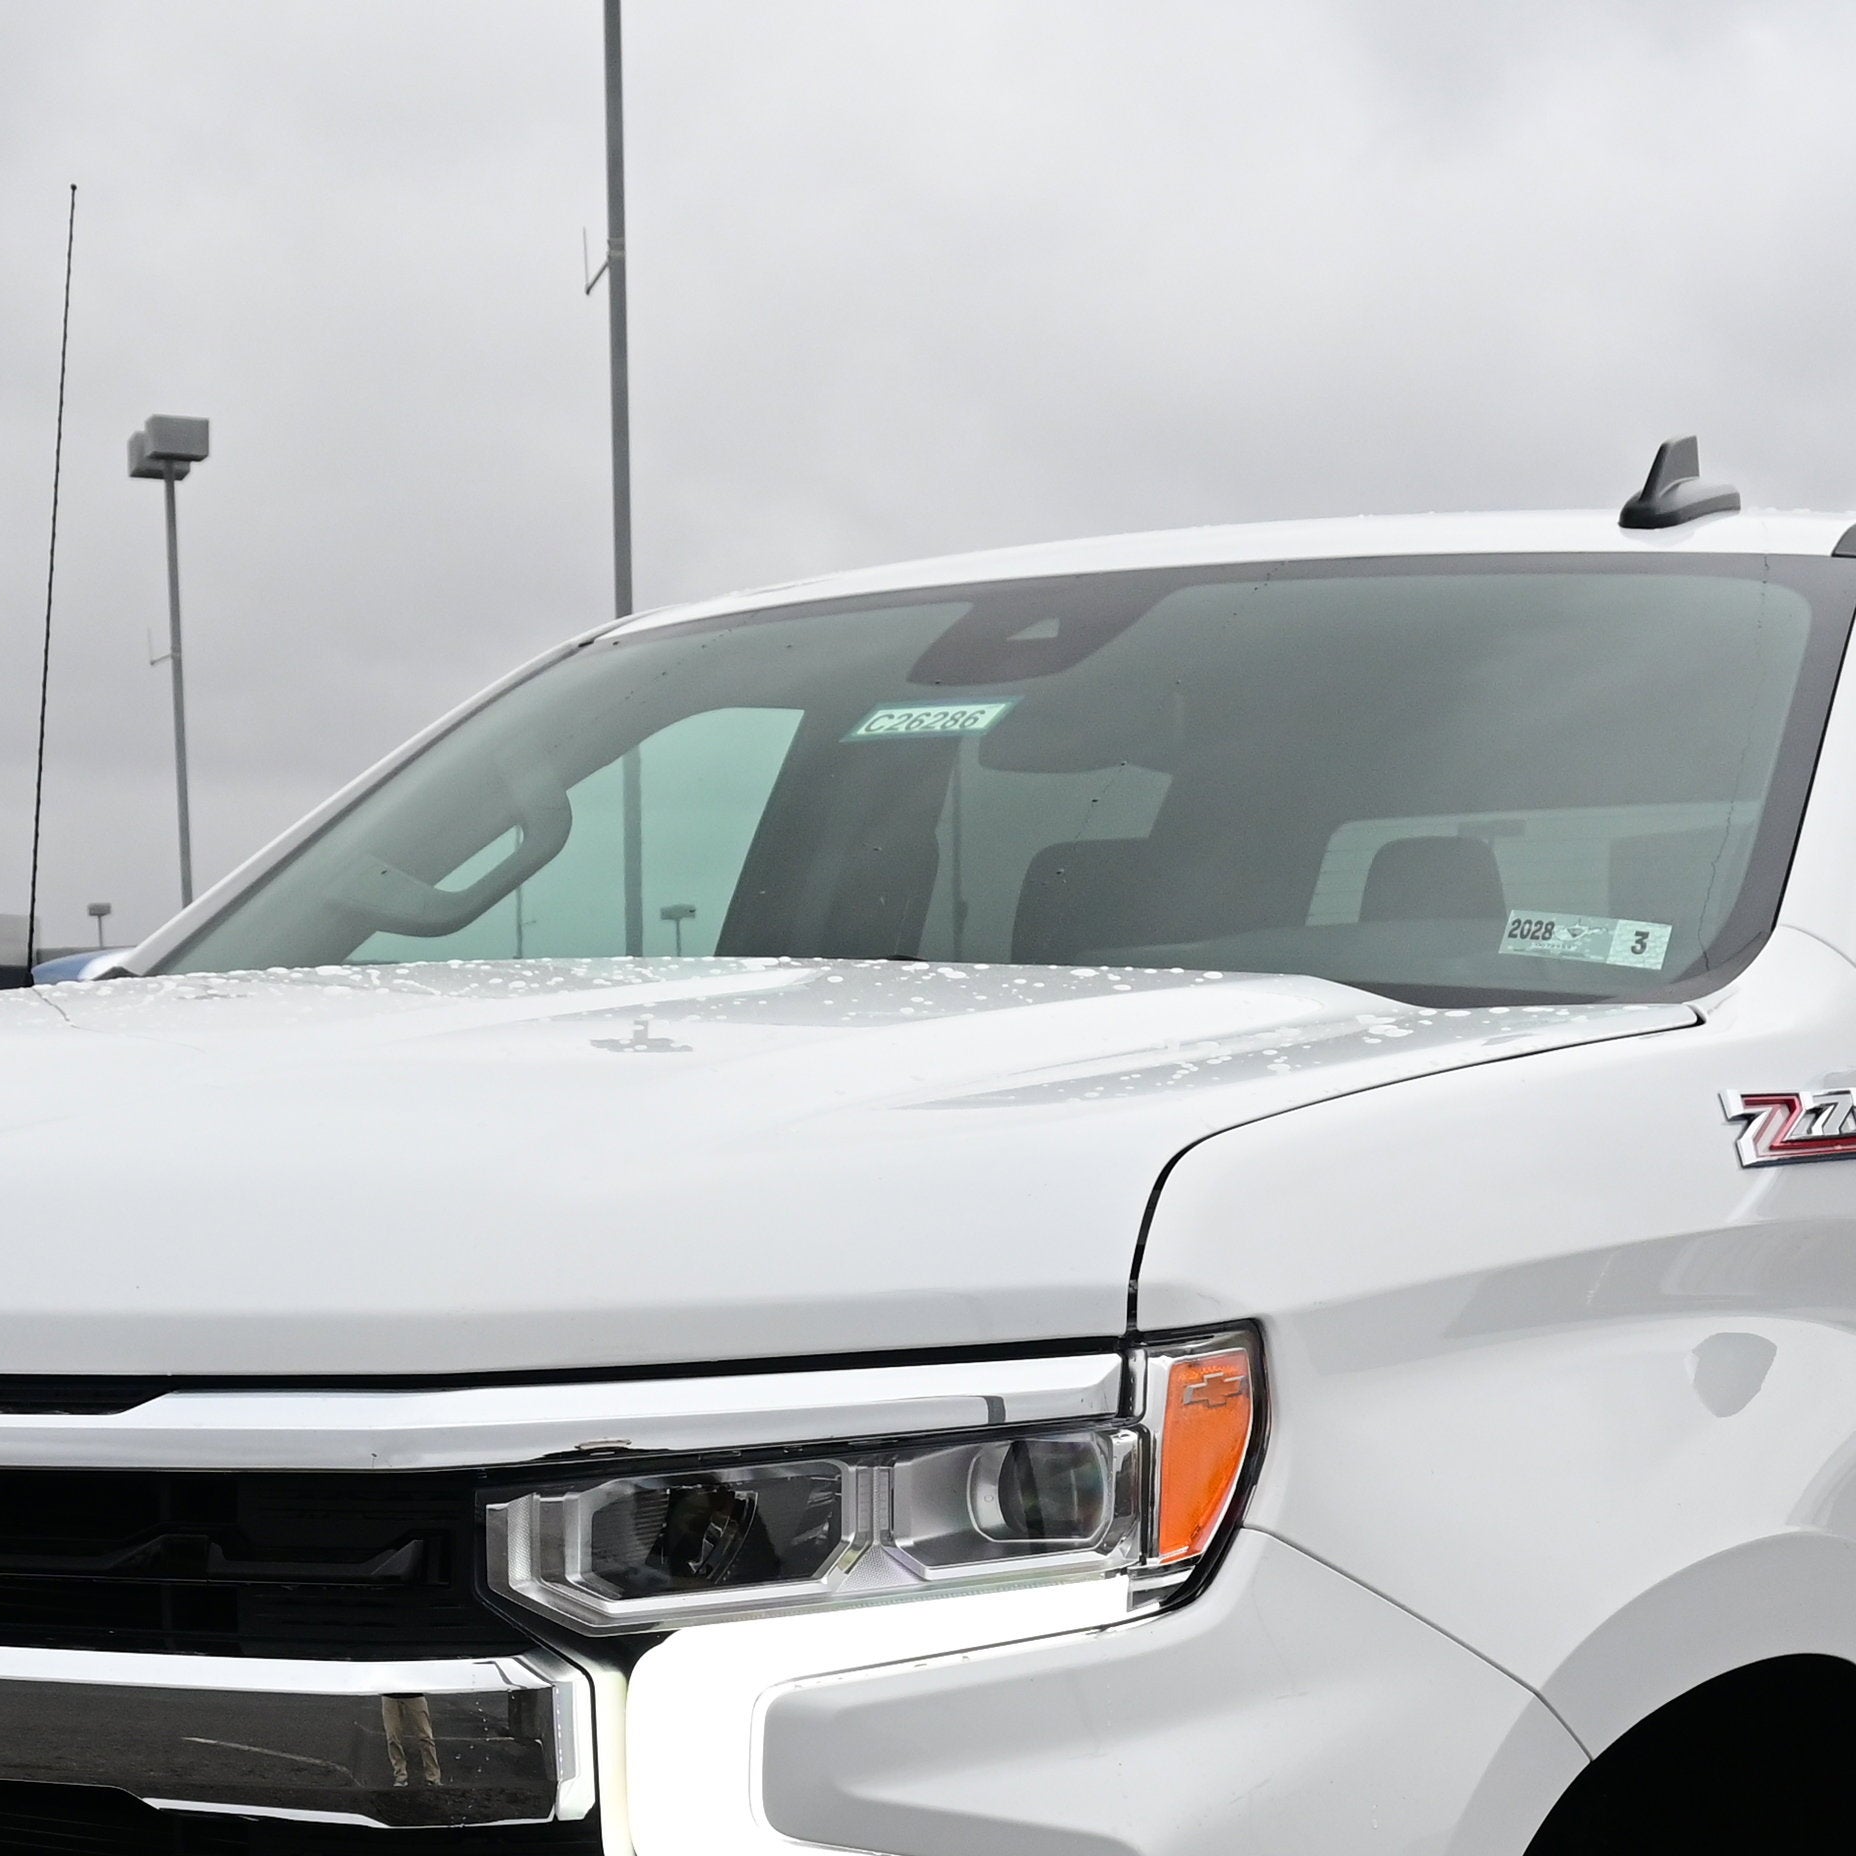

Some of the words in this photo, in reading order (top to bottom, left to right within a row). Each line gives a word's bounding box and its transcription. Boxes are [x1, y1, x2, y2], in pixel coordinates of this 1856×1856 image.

[864, 709, 986, 733] C26286
[1507, 918, 1556, 941] 2028
[1630, 930, 1650, 955] 3
